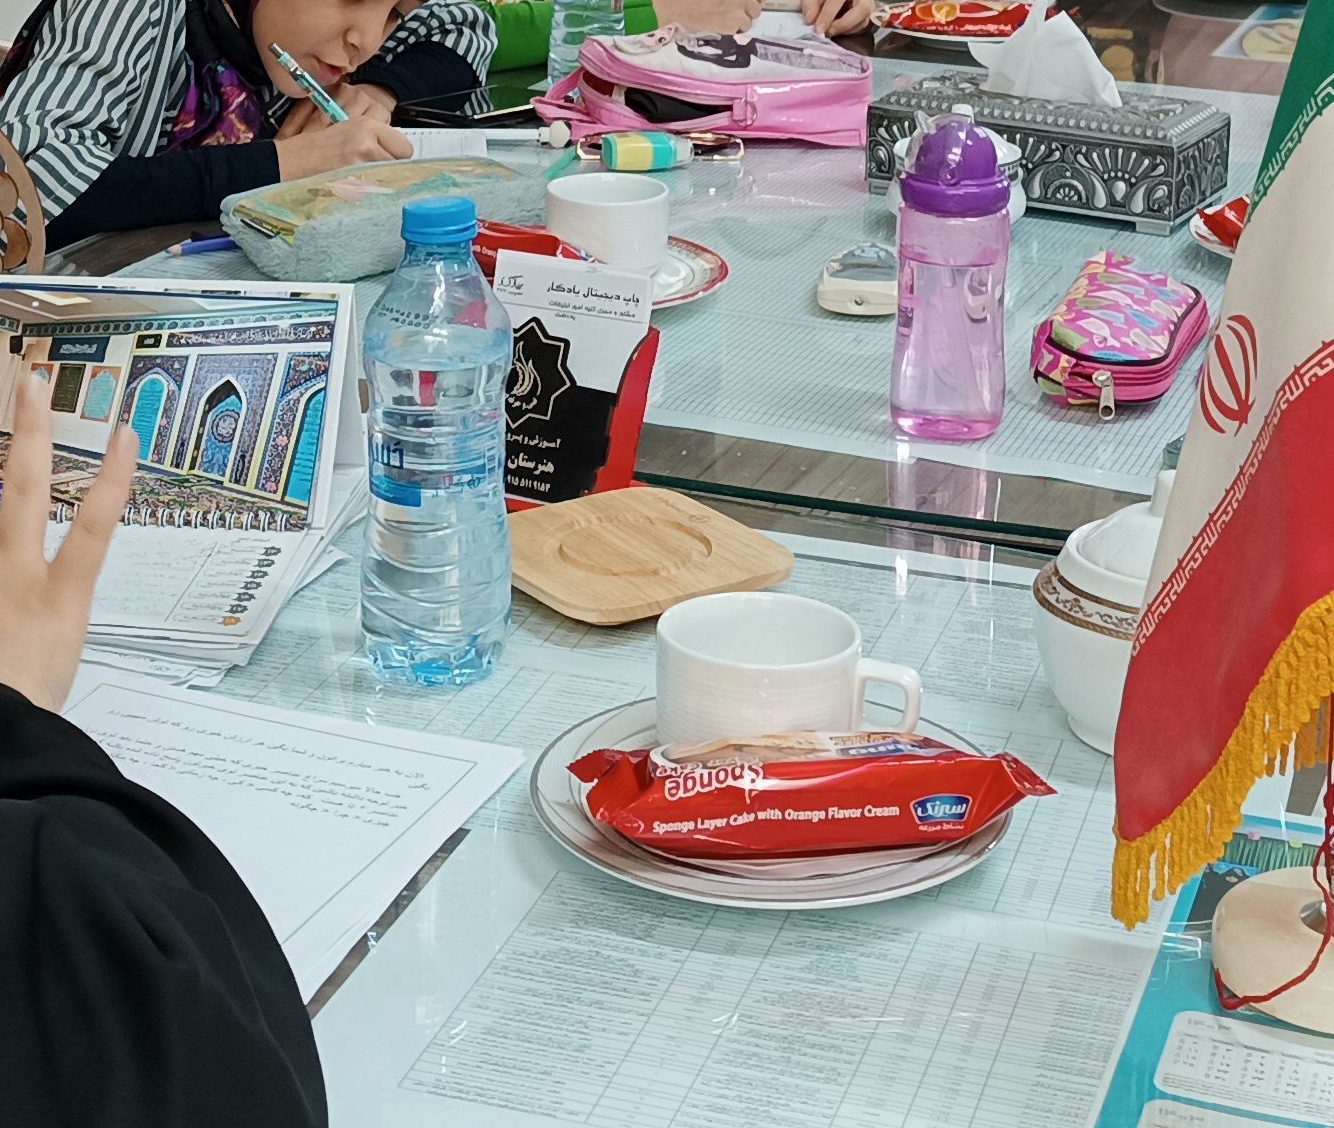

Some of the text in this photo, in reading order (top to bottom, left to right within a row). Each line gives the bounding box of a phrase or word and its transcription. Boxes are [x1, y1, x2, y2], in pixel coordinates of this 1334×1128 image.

[583, 287, 621, 302] دیجیتال
[623, 293, 640, 308] چاپ
[507, 452, 555, 475] هنرستان
[653, 805, 900, 835] Sponge Layer Cake with Orange Flavor Cream
